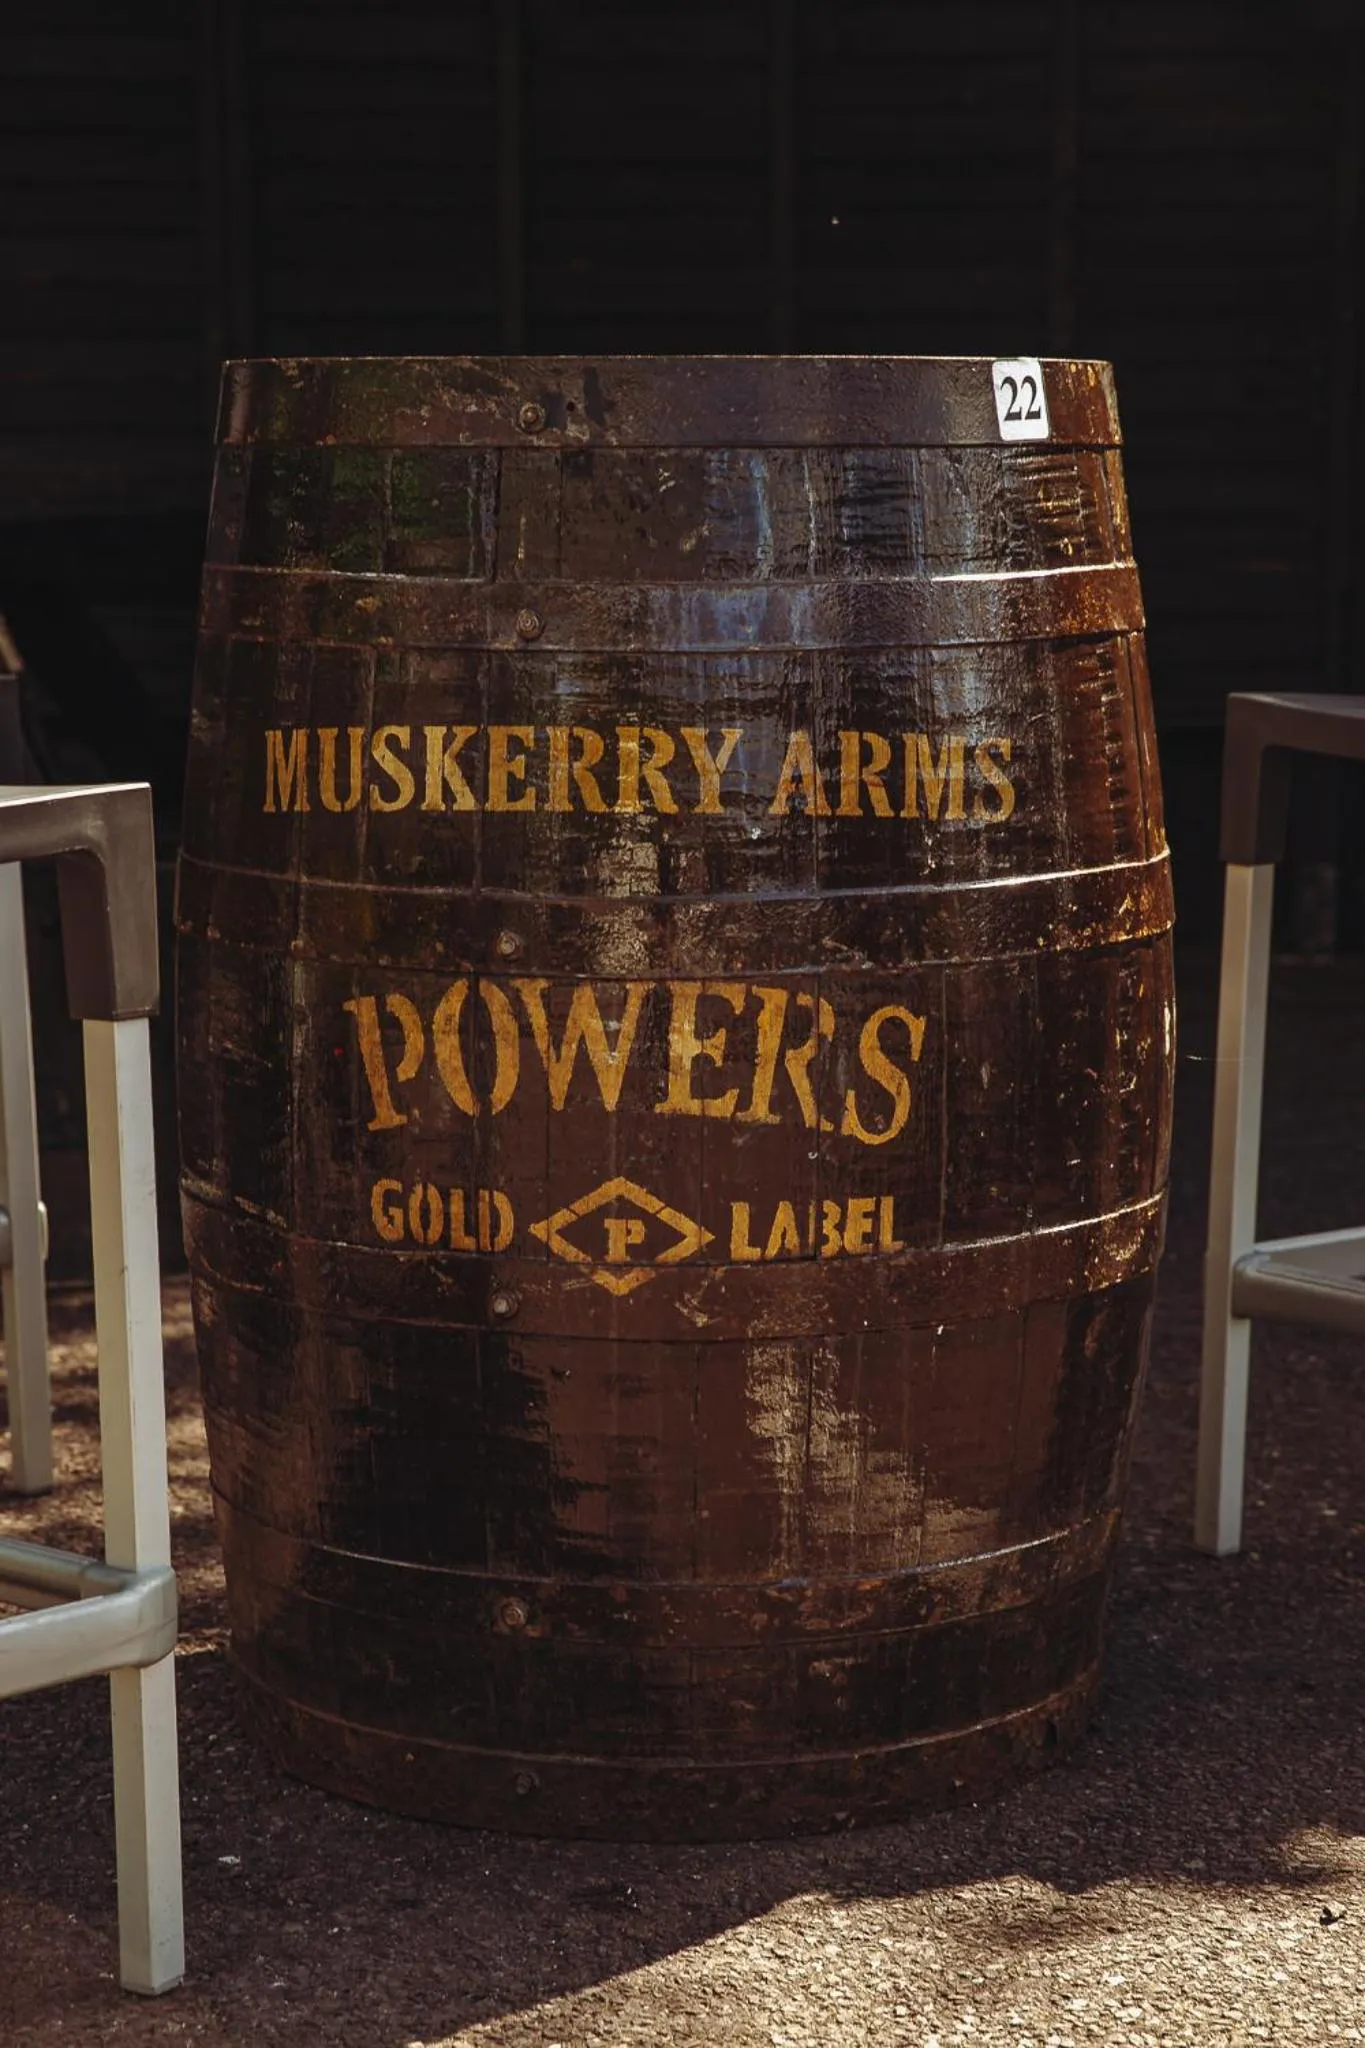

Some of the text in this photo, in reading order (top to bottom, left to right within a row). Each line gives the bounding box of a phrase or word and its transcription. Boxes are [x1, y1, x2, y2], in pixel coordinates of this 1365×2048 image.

[1000, 375, 1041, 421] 22
[263, 725, 1015, 824] MUSKERRY ARMS
[344, 977, 927, 1146] POWERS
[370, 1178, 904, 1262] GOLD P LABEL
